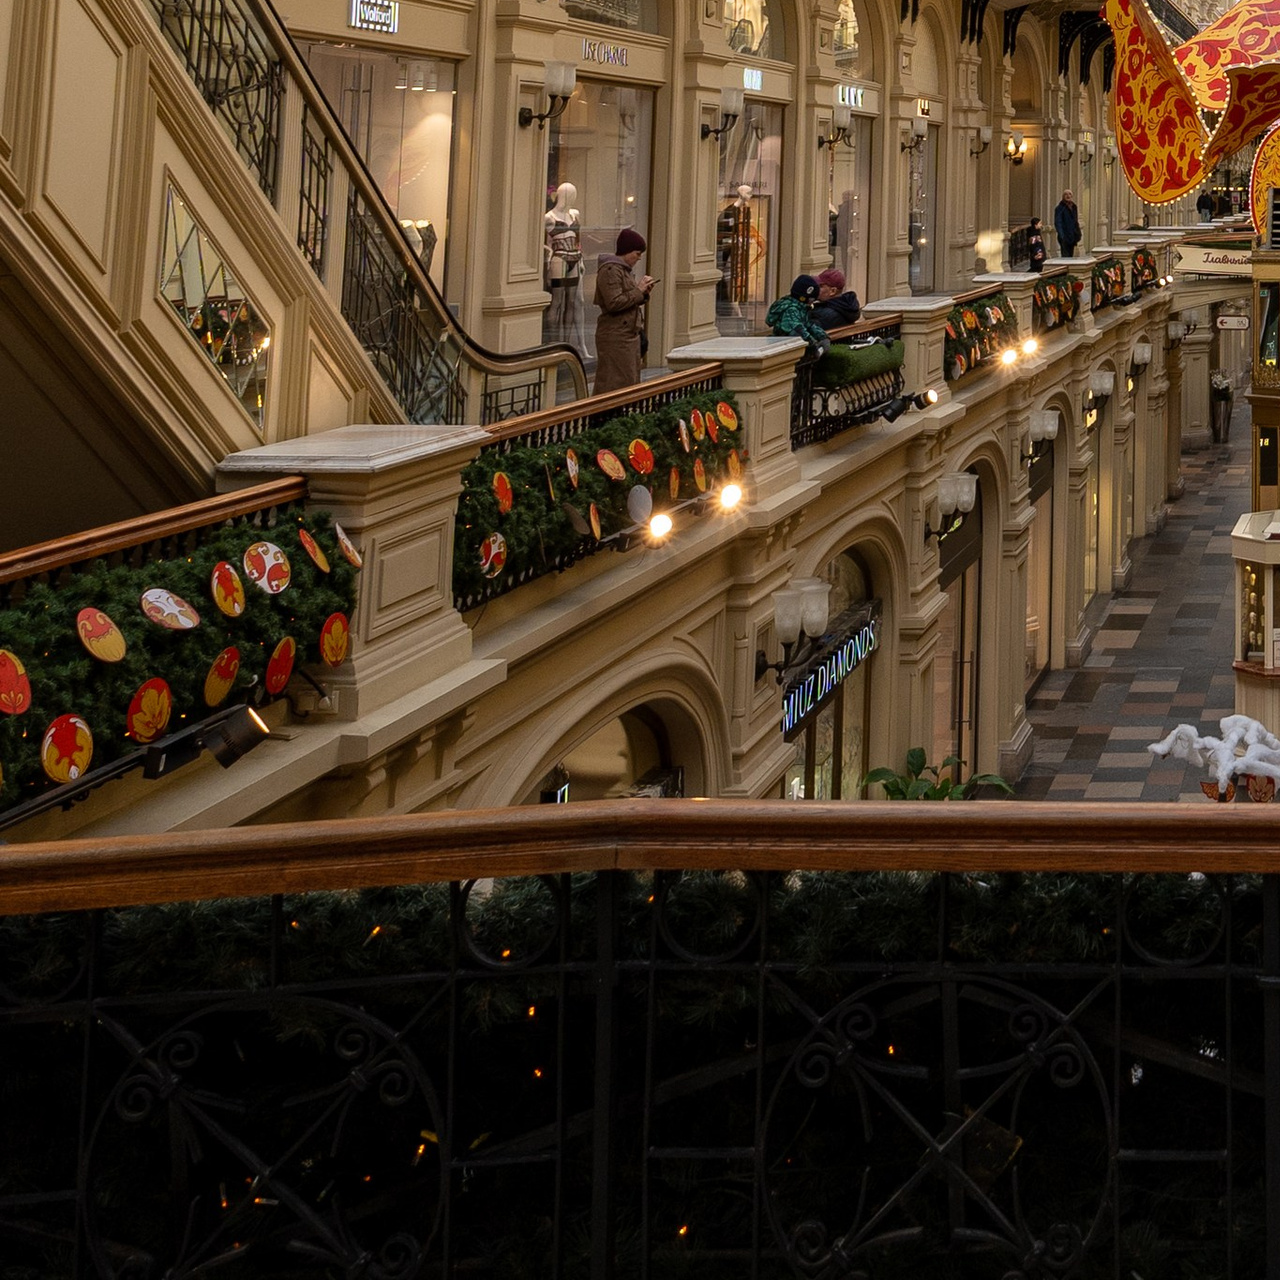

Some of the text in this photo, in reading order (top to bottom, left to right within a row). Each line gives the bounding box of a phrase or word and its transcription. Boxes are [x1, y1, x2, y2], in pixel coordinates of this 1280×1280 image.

[360, 3, 392, 24] Wolford
[1202, 251, 1251, 264] Главный
[781, 620, 876, 734] MIUZ DIAMONDS
